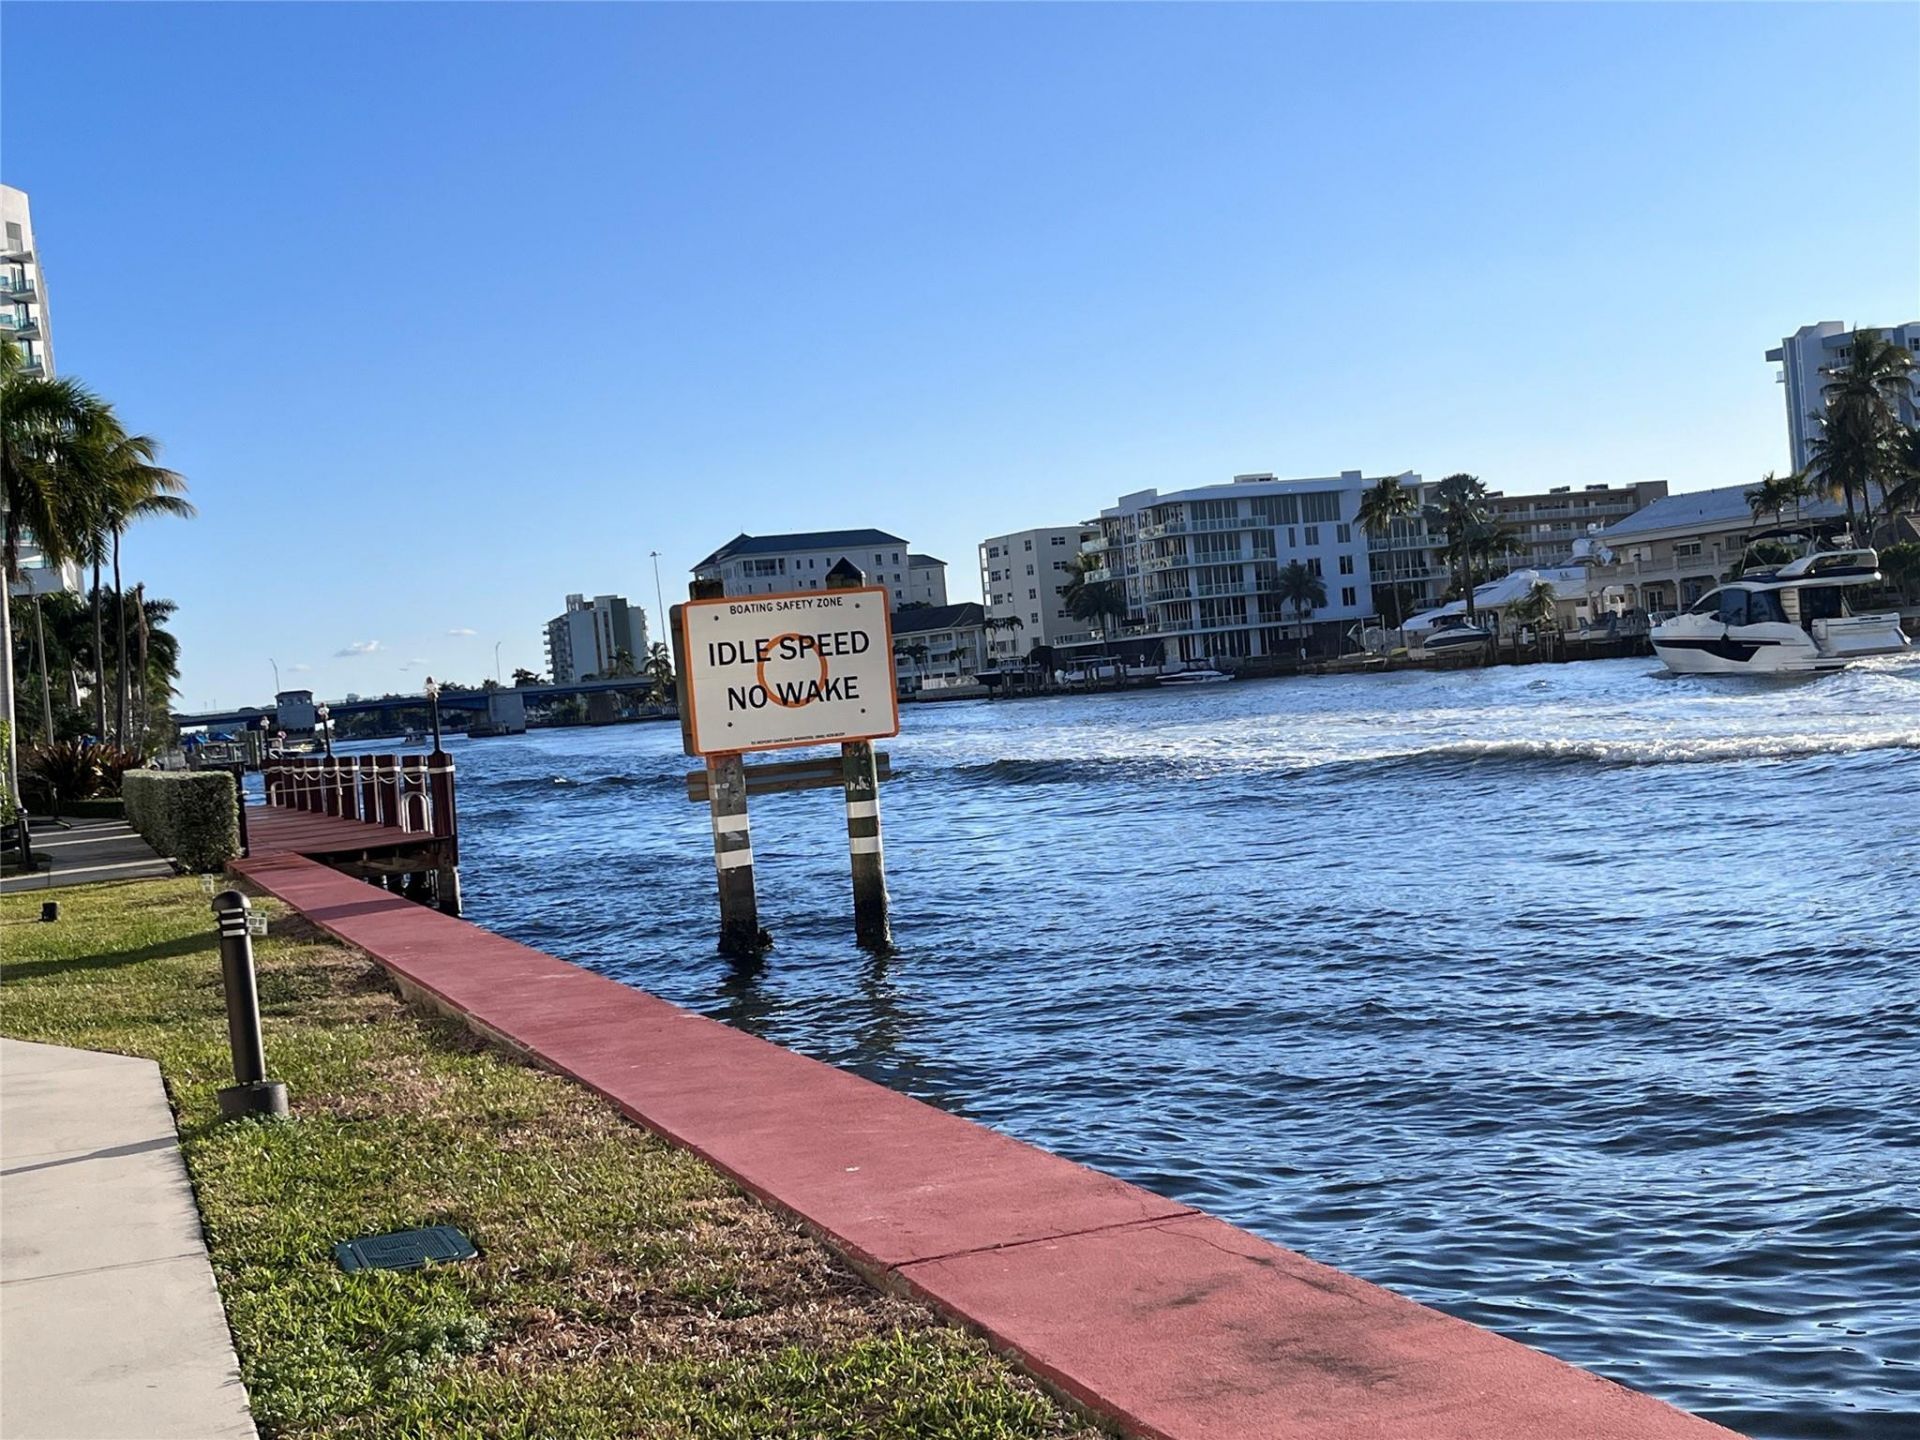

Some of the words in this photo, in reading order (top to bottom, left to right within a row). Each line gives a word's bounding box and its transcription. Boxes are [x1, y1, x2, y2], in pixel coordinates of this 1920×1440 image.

[730, 602, 773, 615] BOATING
[776, 599, 813, 611] SAFETY
[817, 597, 843, 608] ZONE
[709, 638, 771, 666] IDLE
[779, 630, 869, 661] SPEED
[727, 685, 768, 711] NO
[776, 676, 860, 706] WAKE
